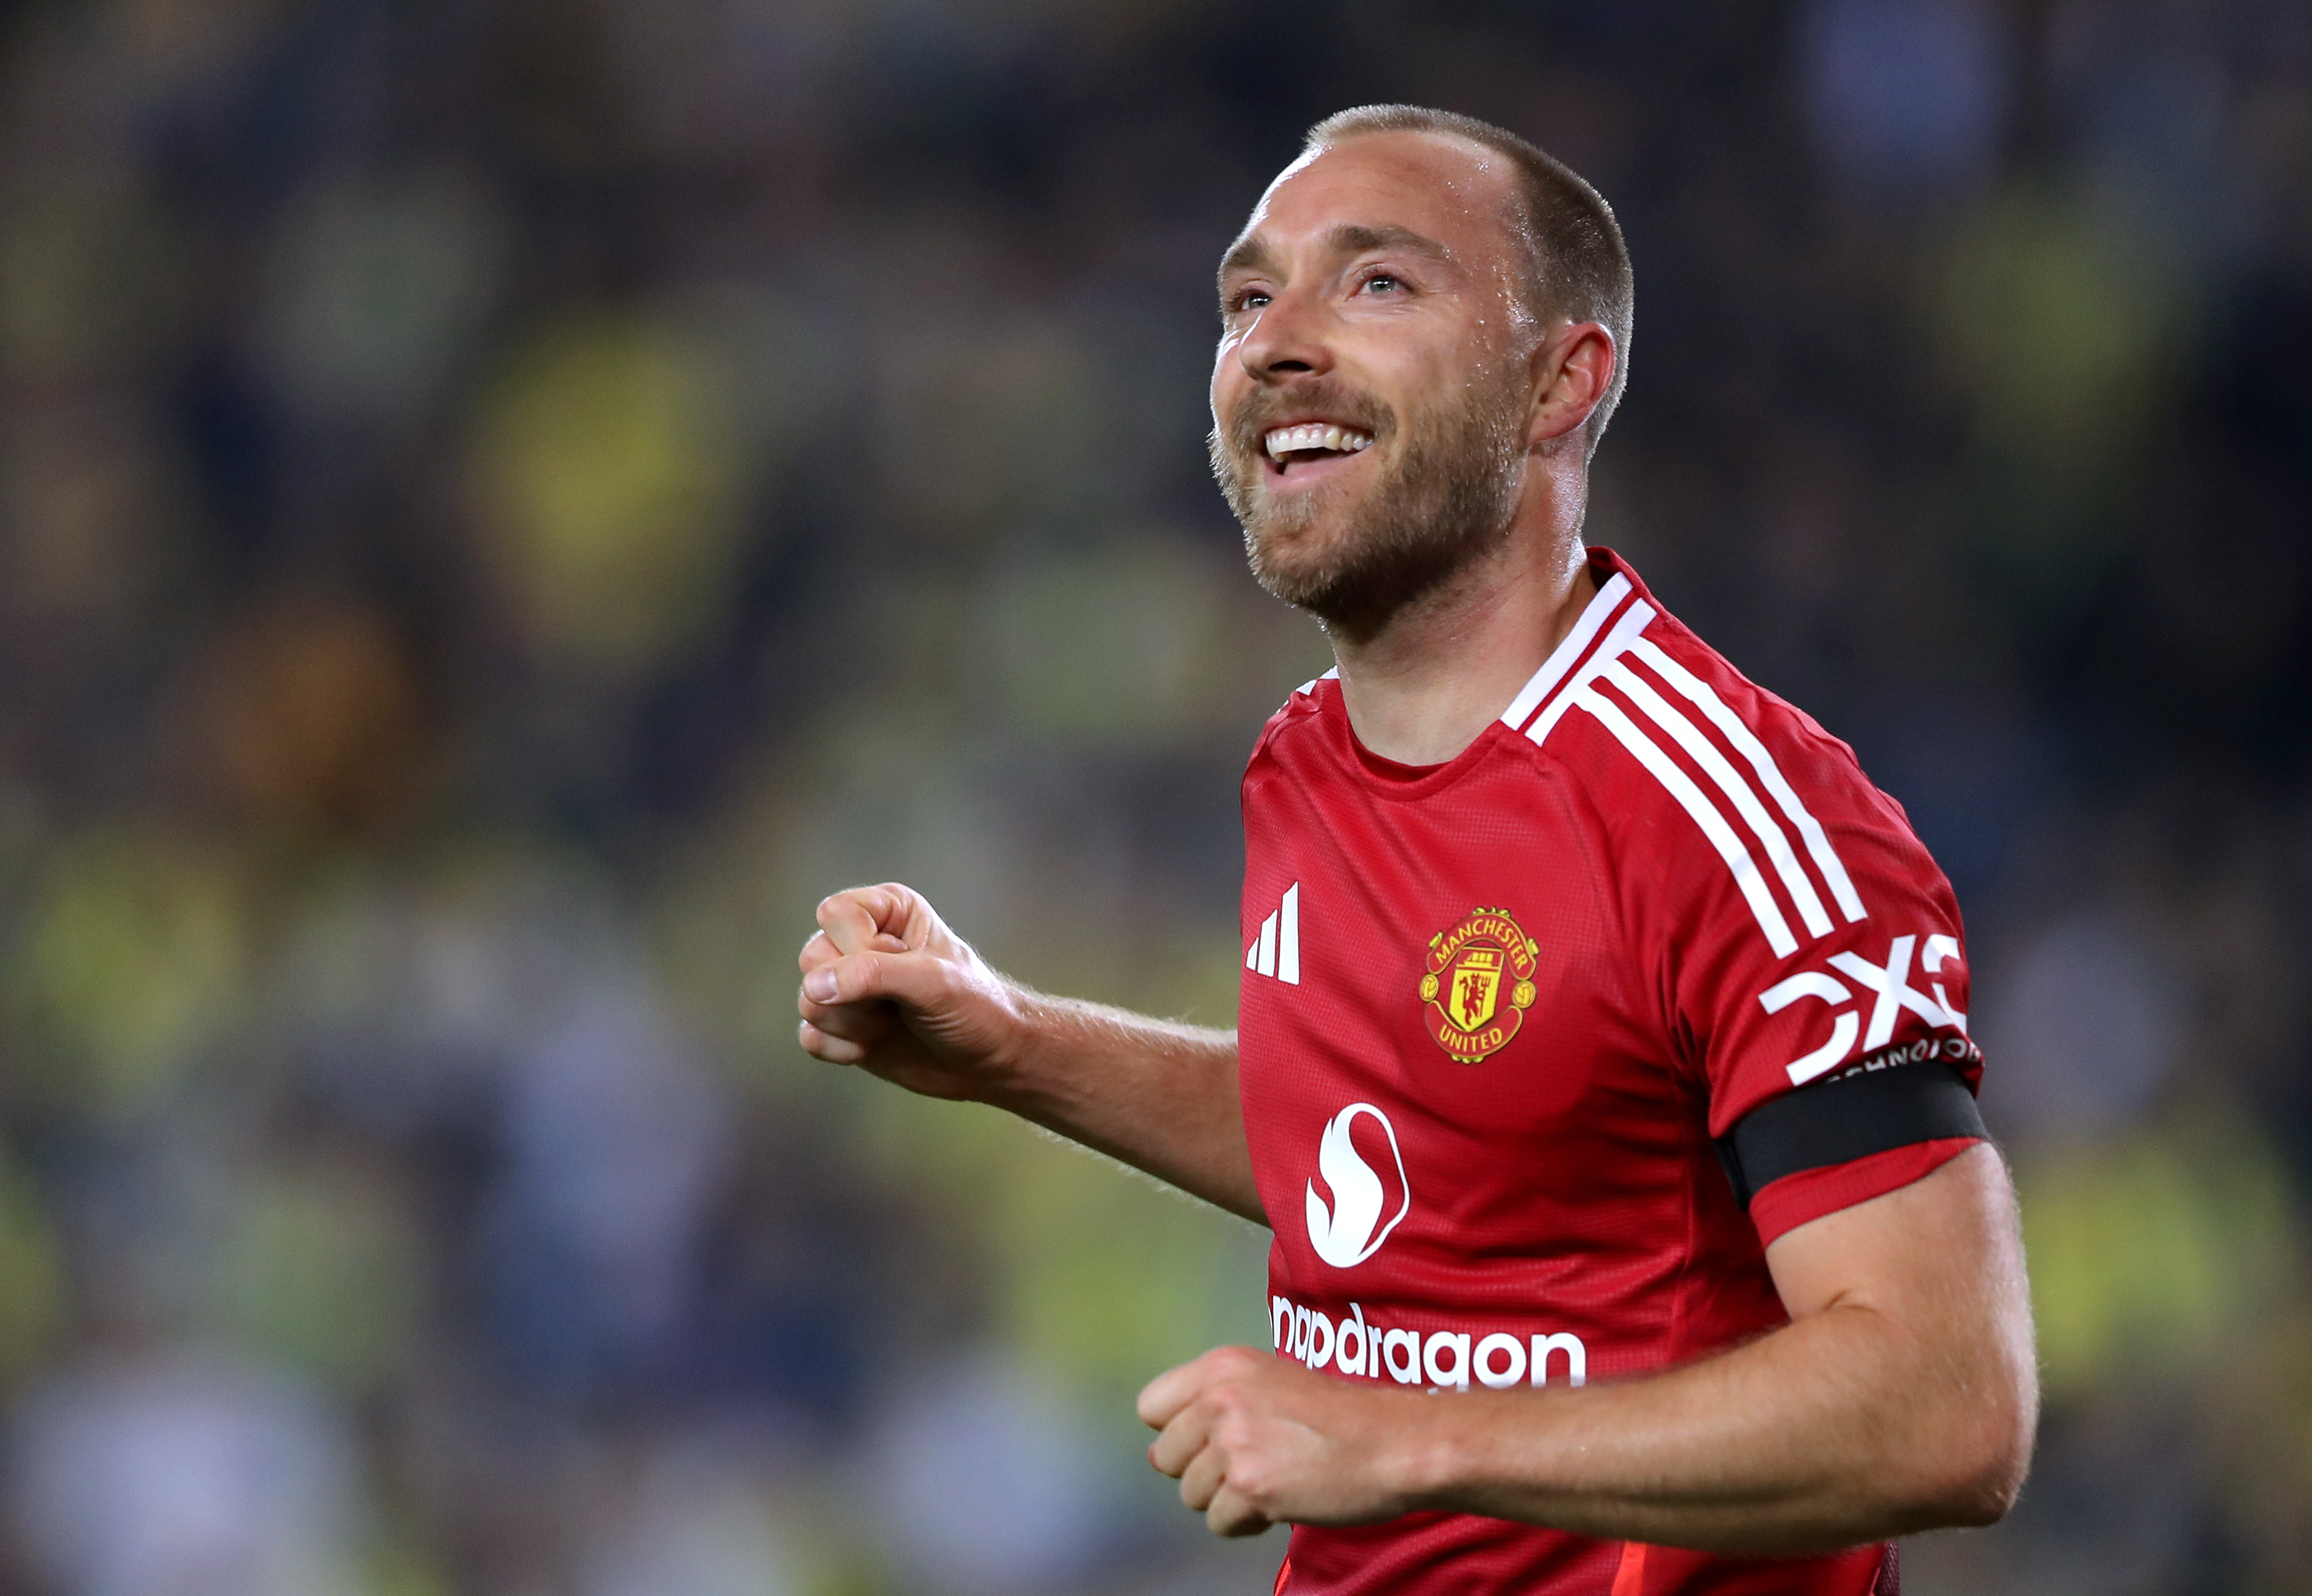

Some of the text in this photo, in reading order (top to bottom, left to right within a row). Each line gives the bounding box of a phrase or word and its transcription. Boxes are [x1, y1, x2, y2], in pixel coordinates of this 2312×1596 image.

[1435, 918, 1528, 970] MANCHESTER
[1439, 1024, 1503, 1052] UNITED
[1268, 1296, 1586, 1395] napdragon
